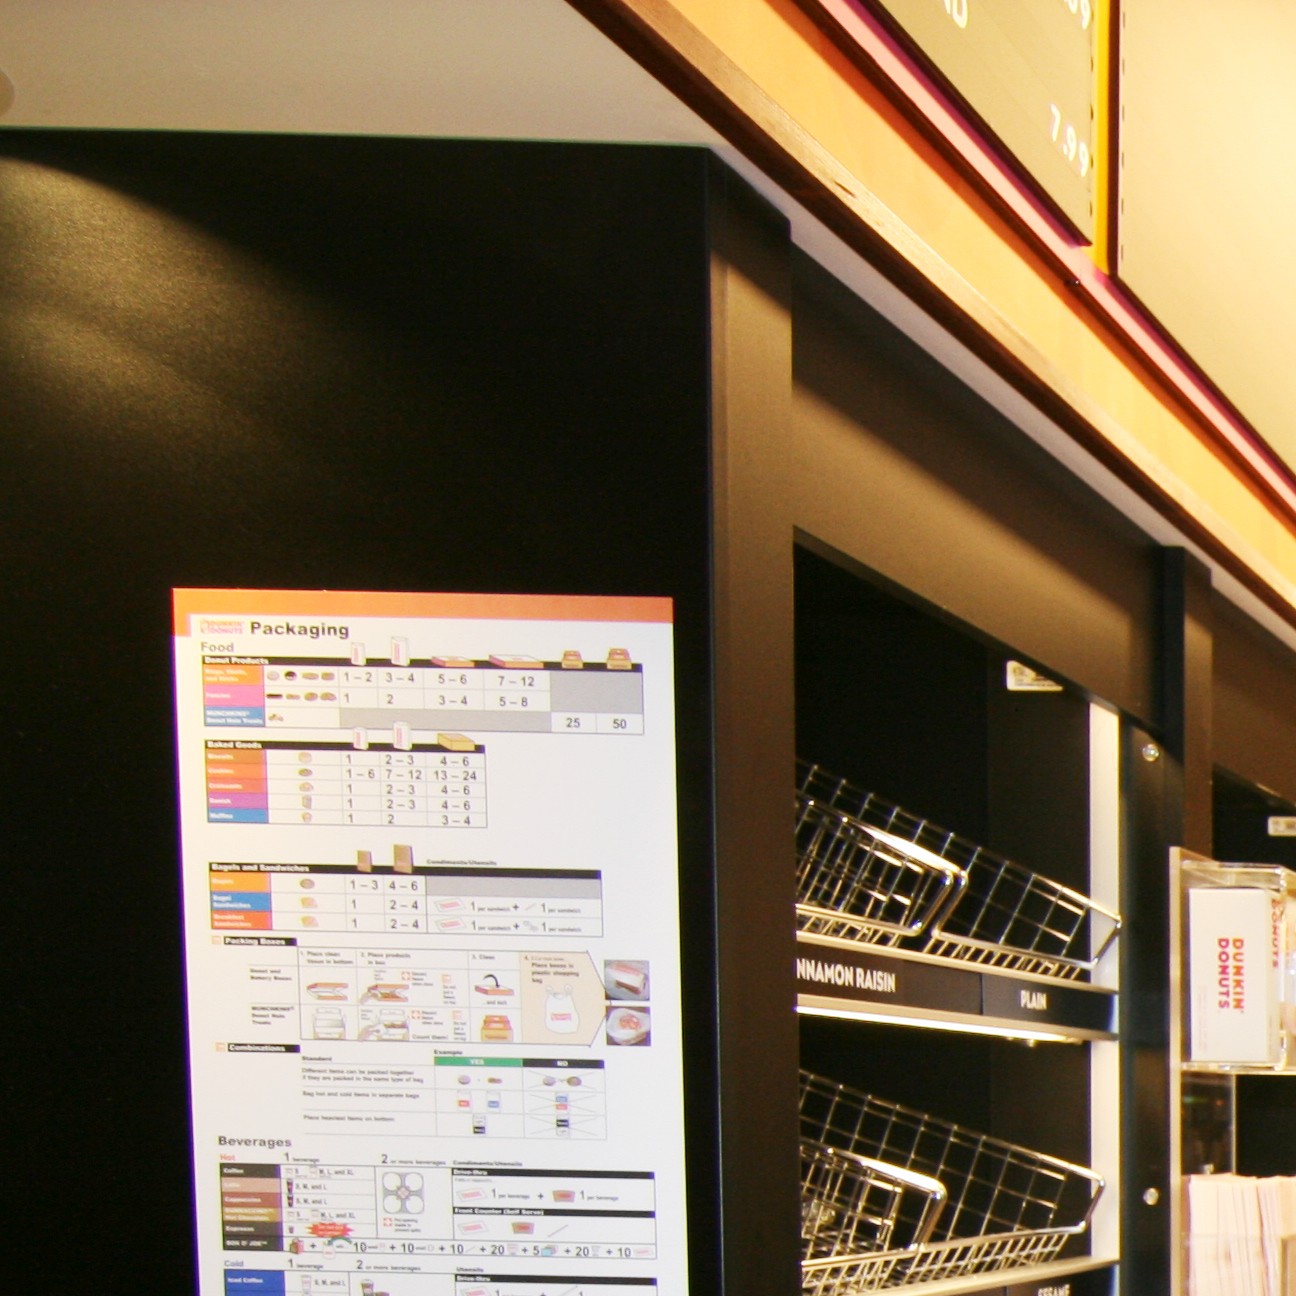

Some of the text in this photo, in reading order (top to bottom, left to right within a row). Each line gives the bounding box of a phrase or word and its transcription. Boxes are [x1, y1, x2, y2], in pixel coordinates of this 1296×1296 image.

[250, 621, 349, 639] Packaging
[200, 641, 235, 653] Food
[565, 717, 627, 729] 25 50
[1217, 937, 1231, 1009] DONUTS
[795, 958, 1048, 1011] NNAMON RAISIN PLAIN
[217, 1135, 292, 1149] Beverages
